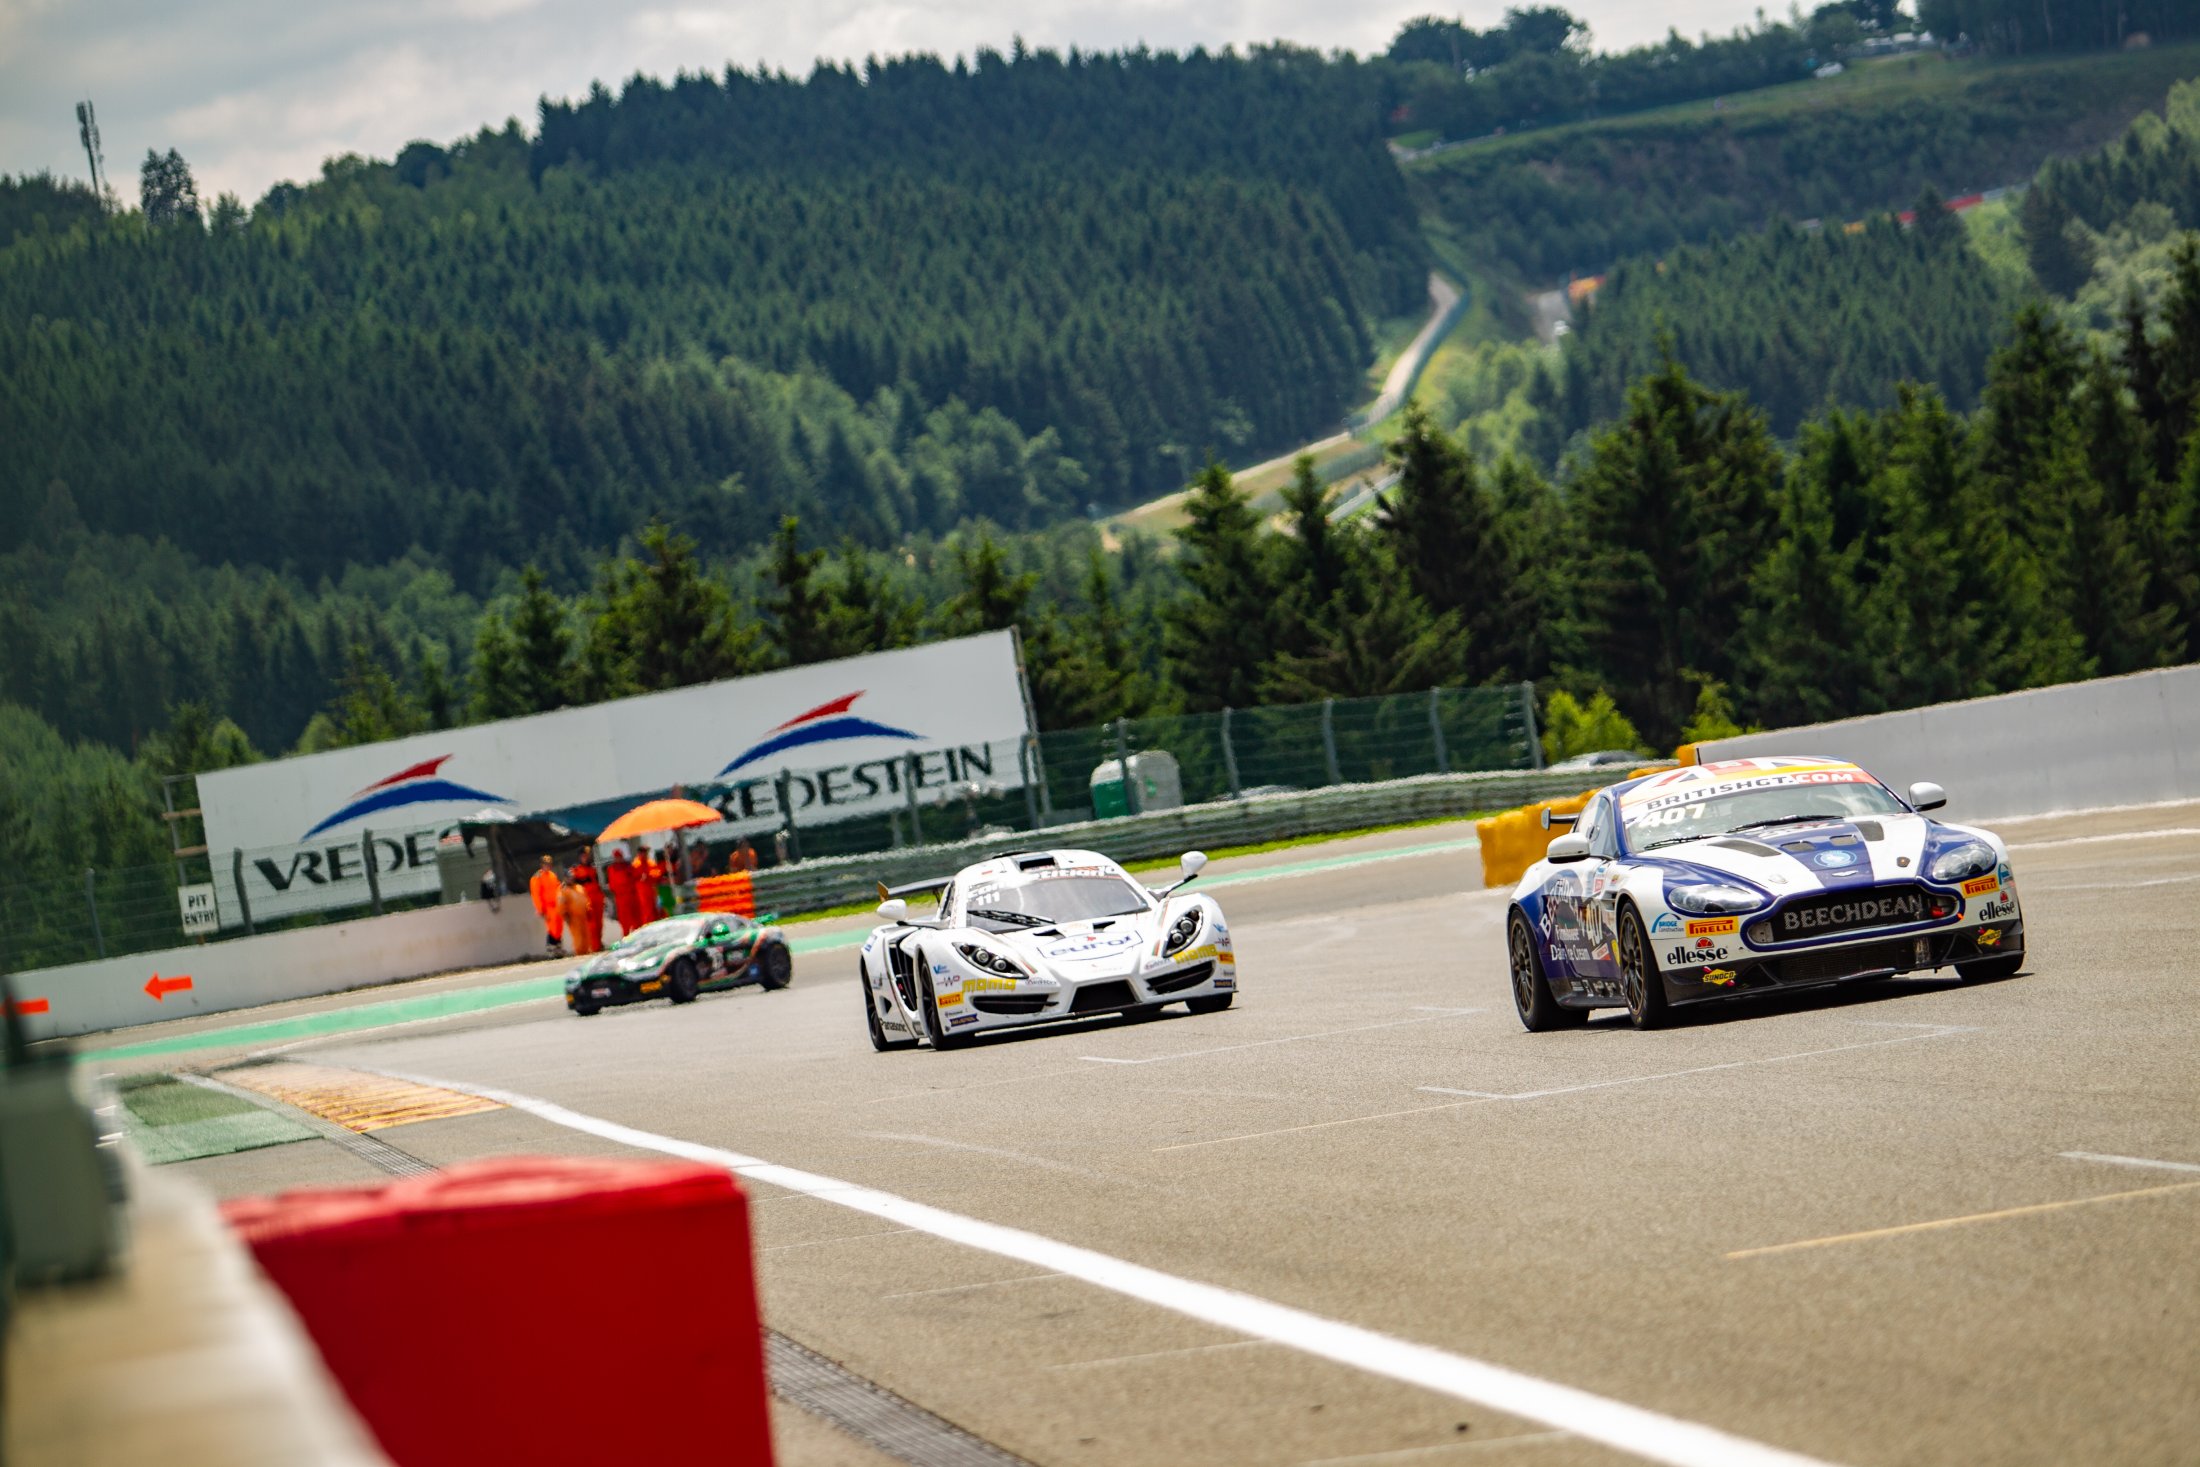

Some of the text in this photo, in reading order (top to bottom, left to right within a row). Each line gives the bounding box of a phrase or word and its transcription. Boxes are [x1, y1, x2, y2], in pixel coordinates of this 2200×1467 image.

[711, 742, 993, 822] REDESTEIN
[1646, 773, 1853, 810] BRITISHGT.COM
[1639, 802, 1706, 828] 407
[1964, 877, 1997, 894] PIRELLI
[188, 894, 206, 907] PIT
[976, 891, 1001, 906] 111
[184, 910, 215, 924] ENTRY
[1784, 895, 1924, 930] BEECHDEAN
[1979, 900, 2015, 921] ellesse
[1689, 920, 1734, 935] PIRELLI
[1667, 946, 1728, 965] ellesse
[1704, 971, 1736, 981] SUNOCO
